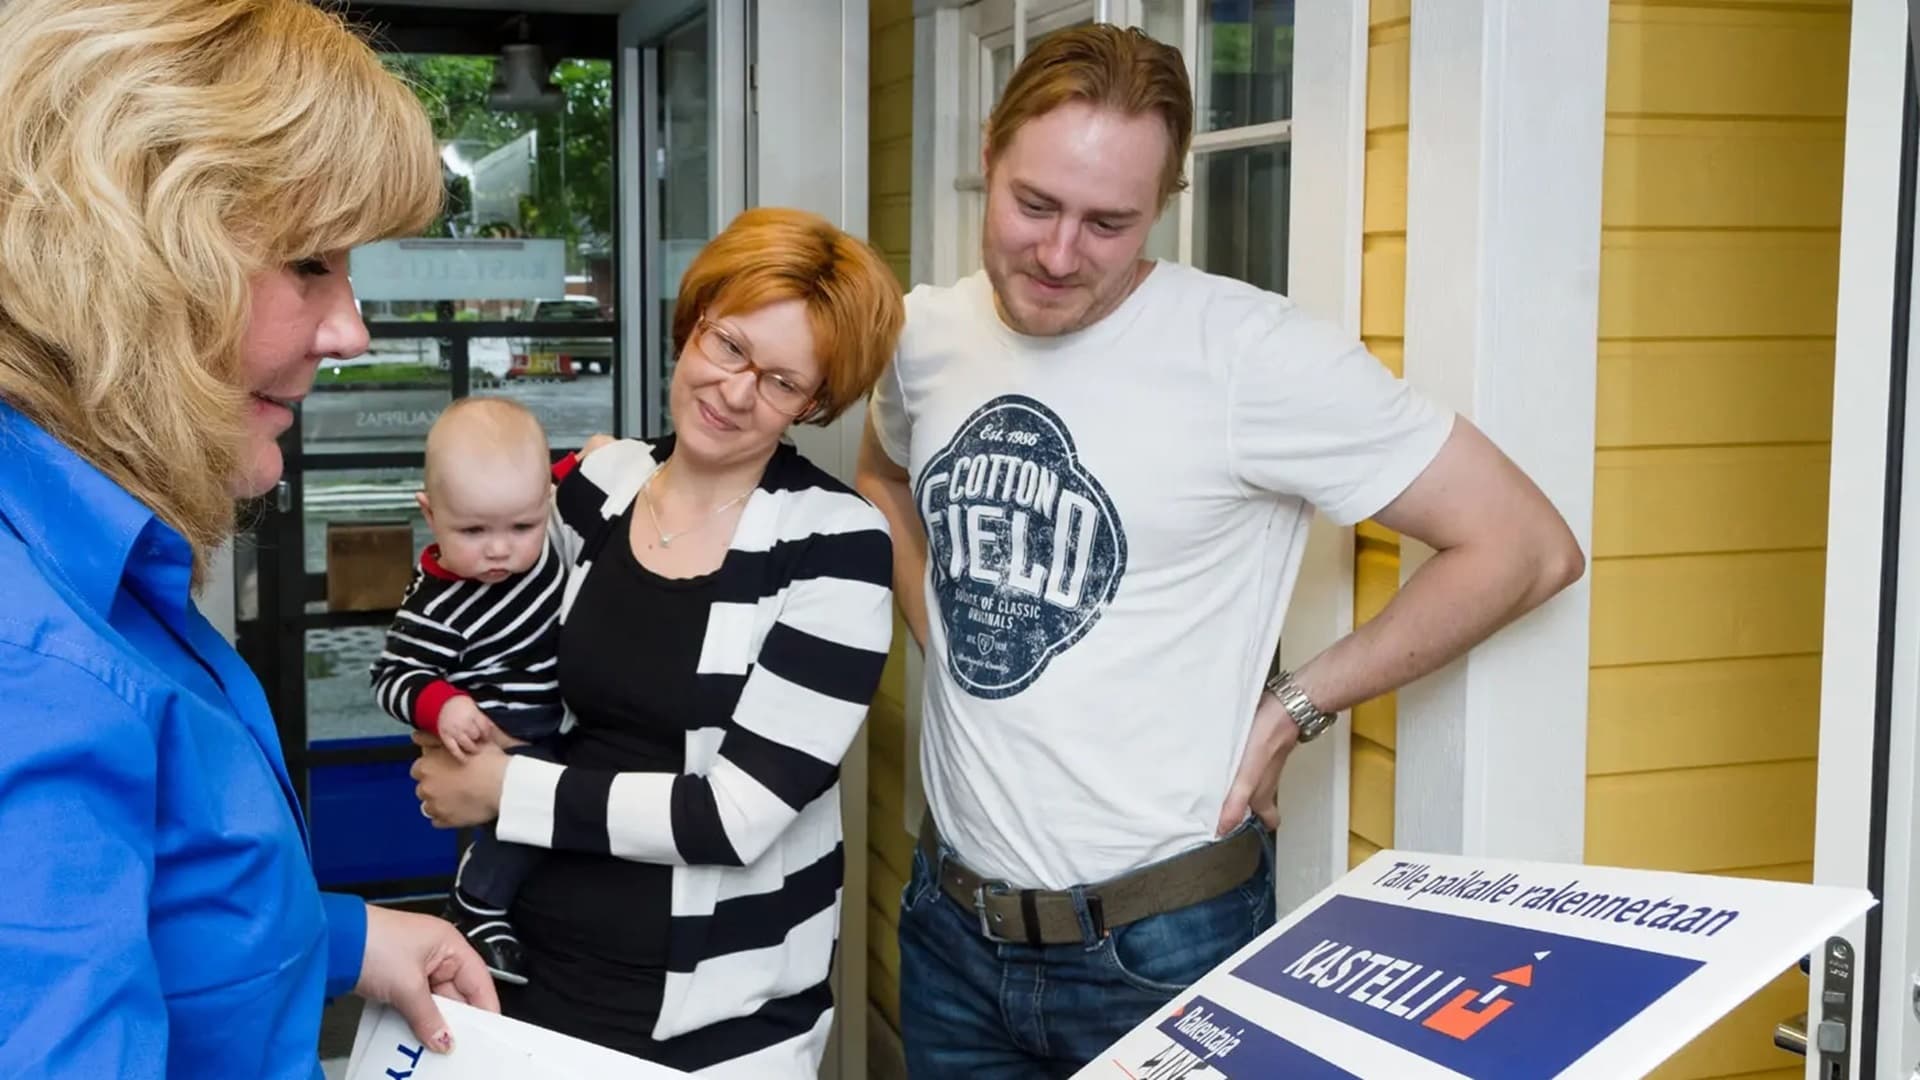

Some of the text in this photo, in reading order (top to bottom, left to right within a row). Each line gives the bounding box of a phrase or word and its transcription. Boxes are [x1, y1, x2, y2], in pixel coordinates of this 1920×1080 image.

[979, 424, 1041, 447] Est. 1986
[949, 453, 1059, 520] COTTON
[922, 472, 1100, 612] FIELD
[981, 596, 995, 611] OF
[997, 600, 1042, 620] CLASSIC
[1372, 862, 1740, 937] Tälle paikalle rakennetaan
[1282, 939, 1467, 1021] KASTELLI
[1174, 1005, 1245, 1060] Rakentaja
